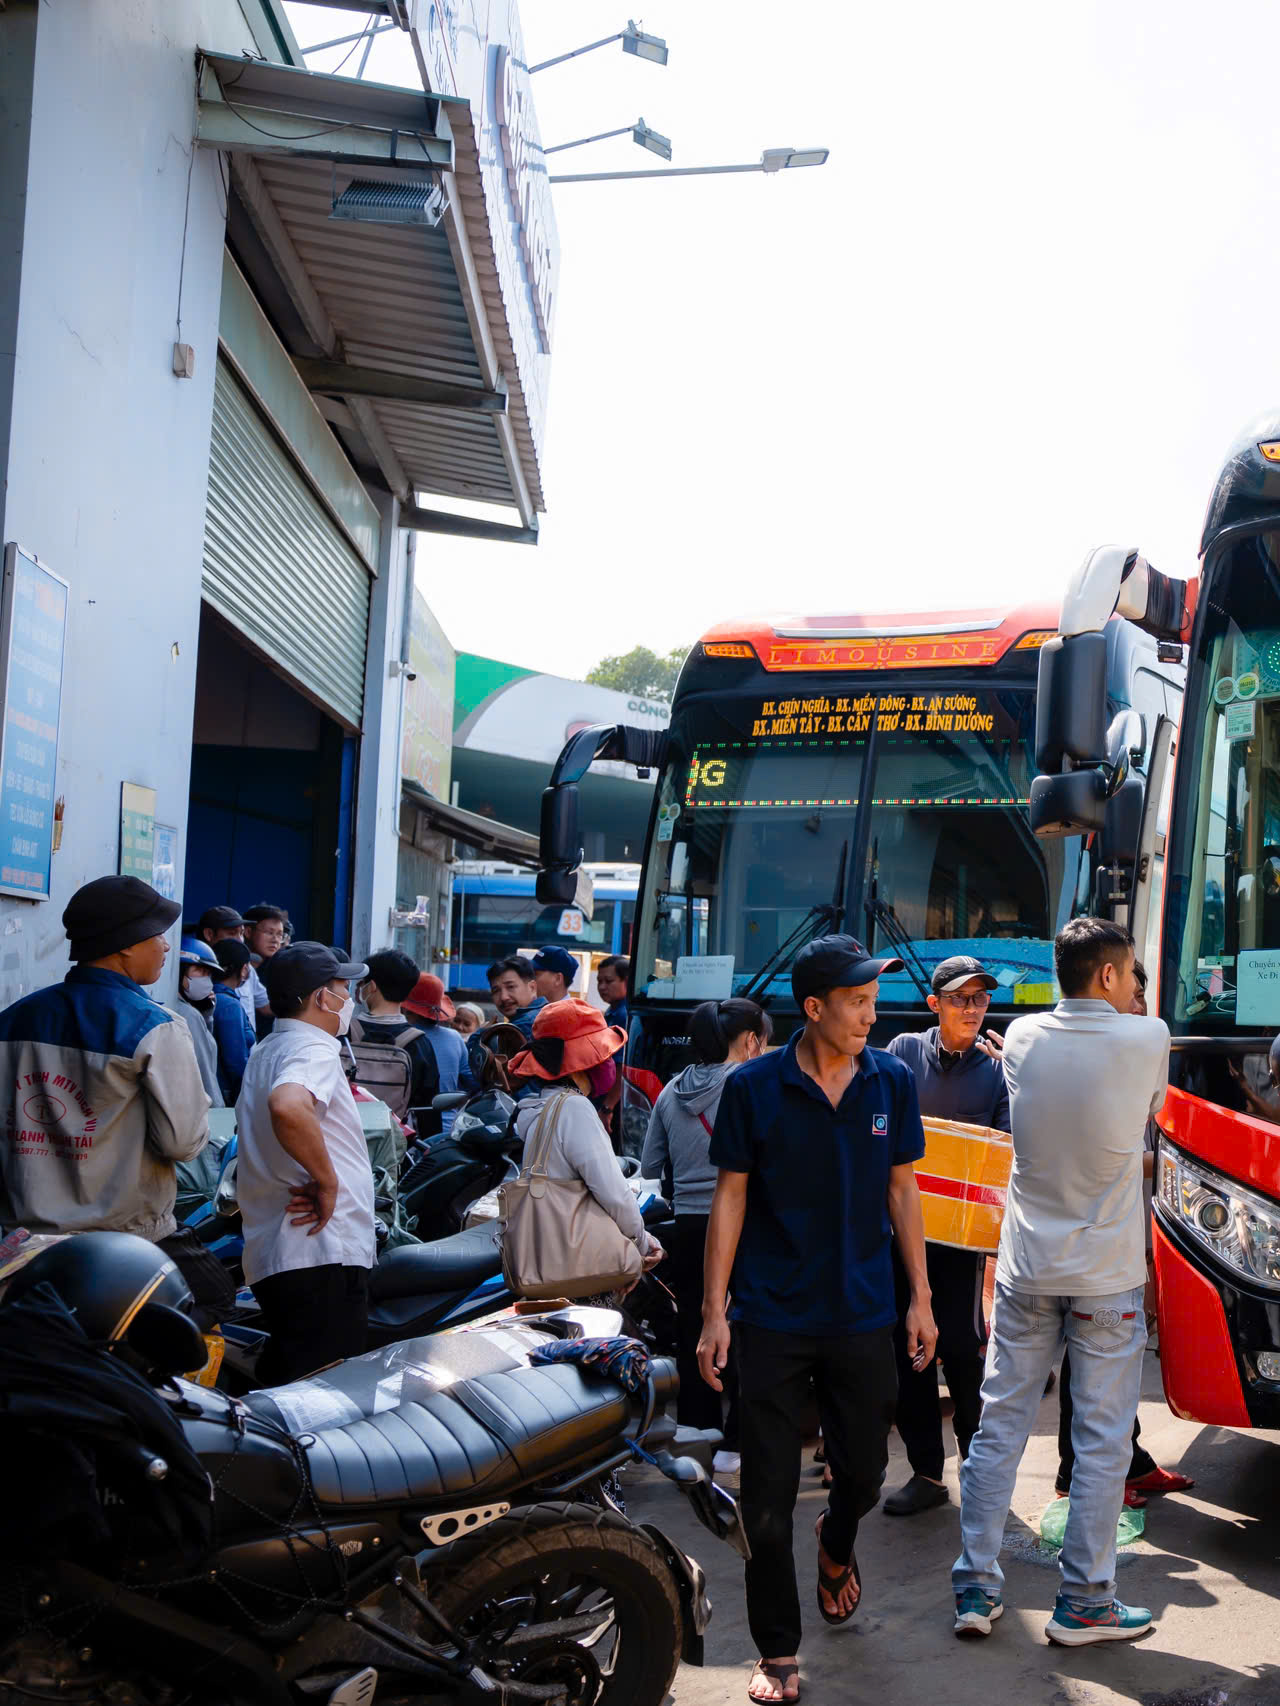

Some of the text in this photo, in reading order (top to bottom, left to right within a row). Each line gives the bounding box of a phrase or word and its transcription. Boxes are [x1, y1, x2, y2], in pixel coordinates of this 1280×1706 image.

[768, 641, 999, 664] LIMOUSINE
[762, 702, 777, 716] BX.
[778, 697, 800, 716] CHÍN
[801, 695, 830, 713] NGHĨA
[835, 697, 851, 712] BX.
[852, 692, 876, 711] MIỀN
[911, 697, 928, 711] BX.
[944, 693, 977, 711] SƯƠNG
[752, 711, 993, 737] BX. MIỀN TÂY BX. CẦN THƠ BX. BÌNH DƯƠNG
[562, 913, 582, 932] 33
[661, 1036, 692, 1046] NOBLE
